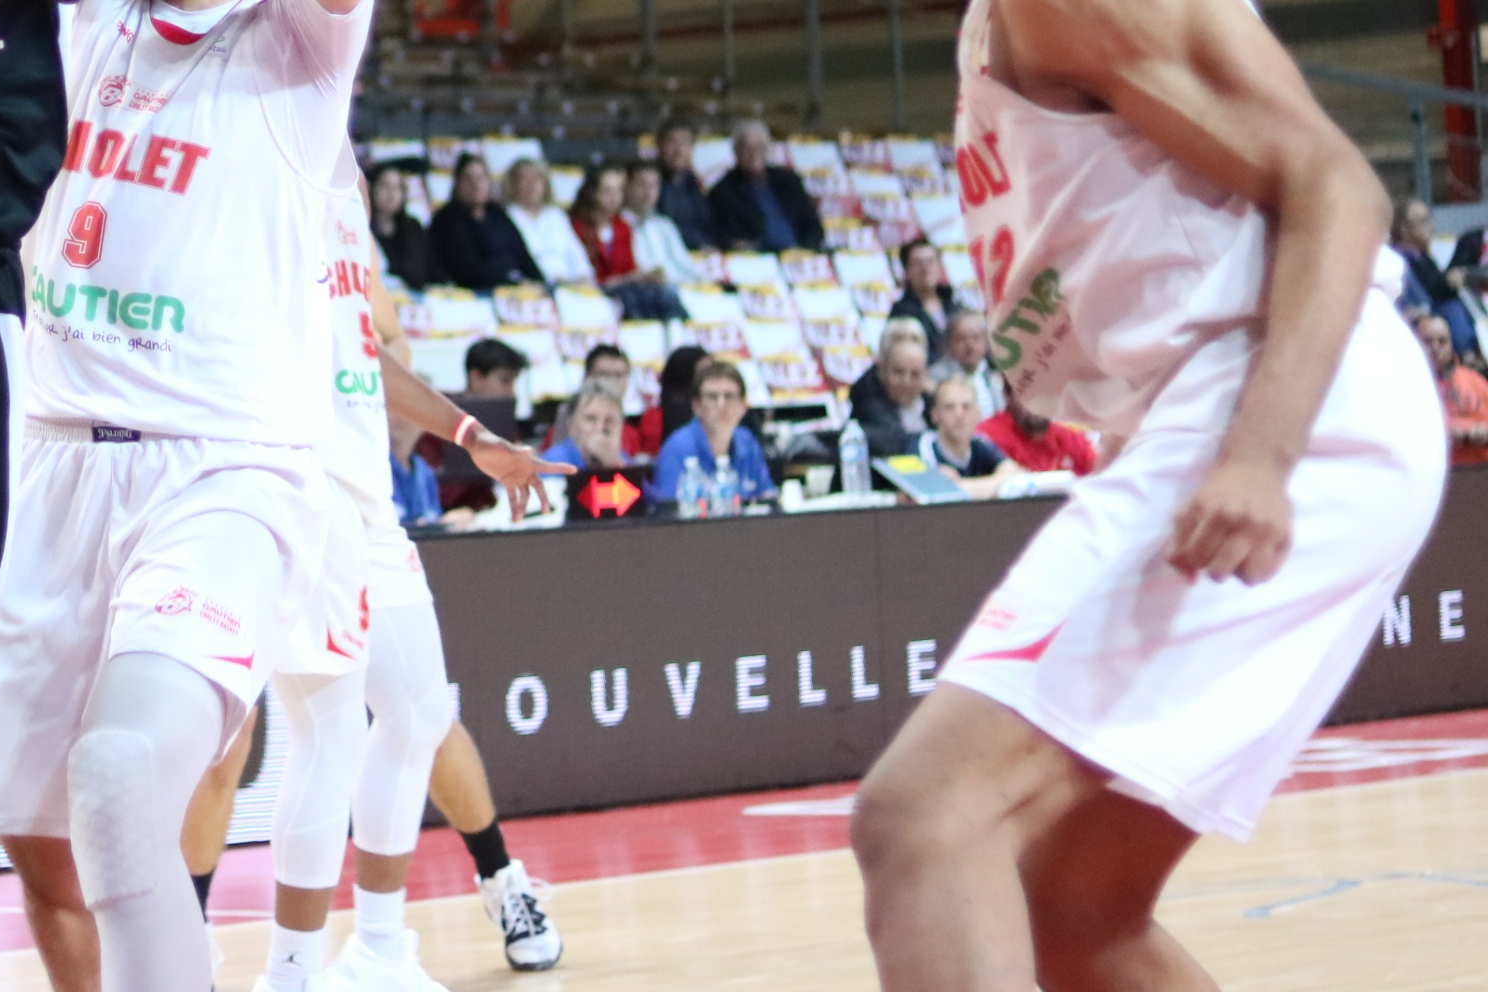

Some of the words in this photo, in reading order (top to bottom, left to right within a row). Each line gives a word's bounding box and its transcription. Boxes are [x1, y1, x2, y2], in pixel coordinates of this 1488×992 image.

[62, 119, 212, 197] OLET
[62, 201, 108, 269] 9
[92, 331, 121, 345] bien
[449, 637, 938, 736] OUVELLE
